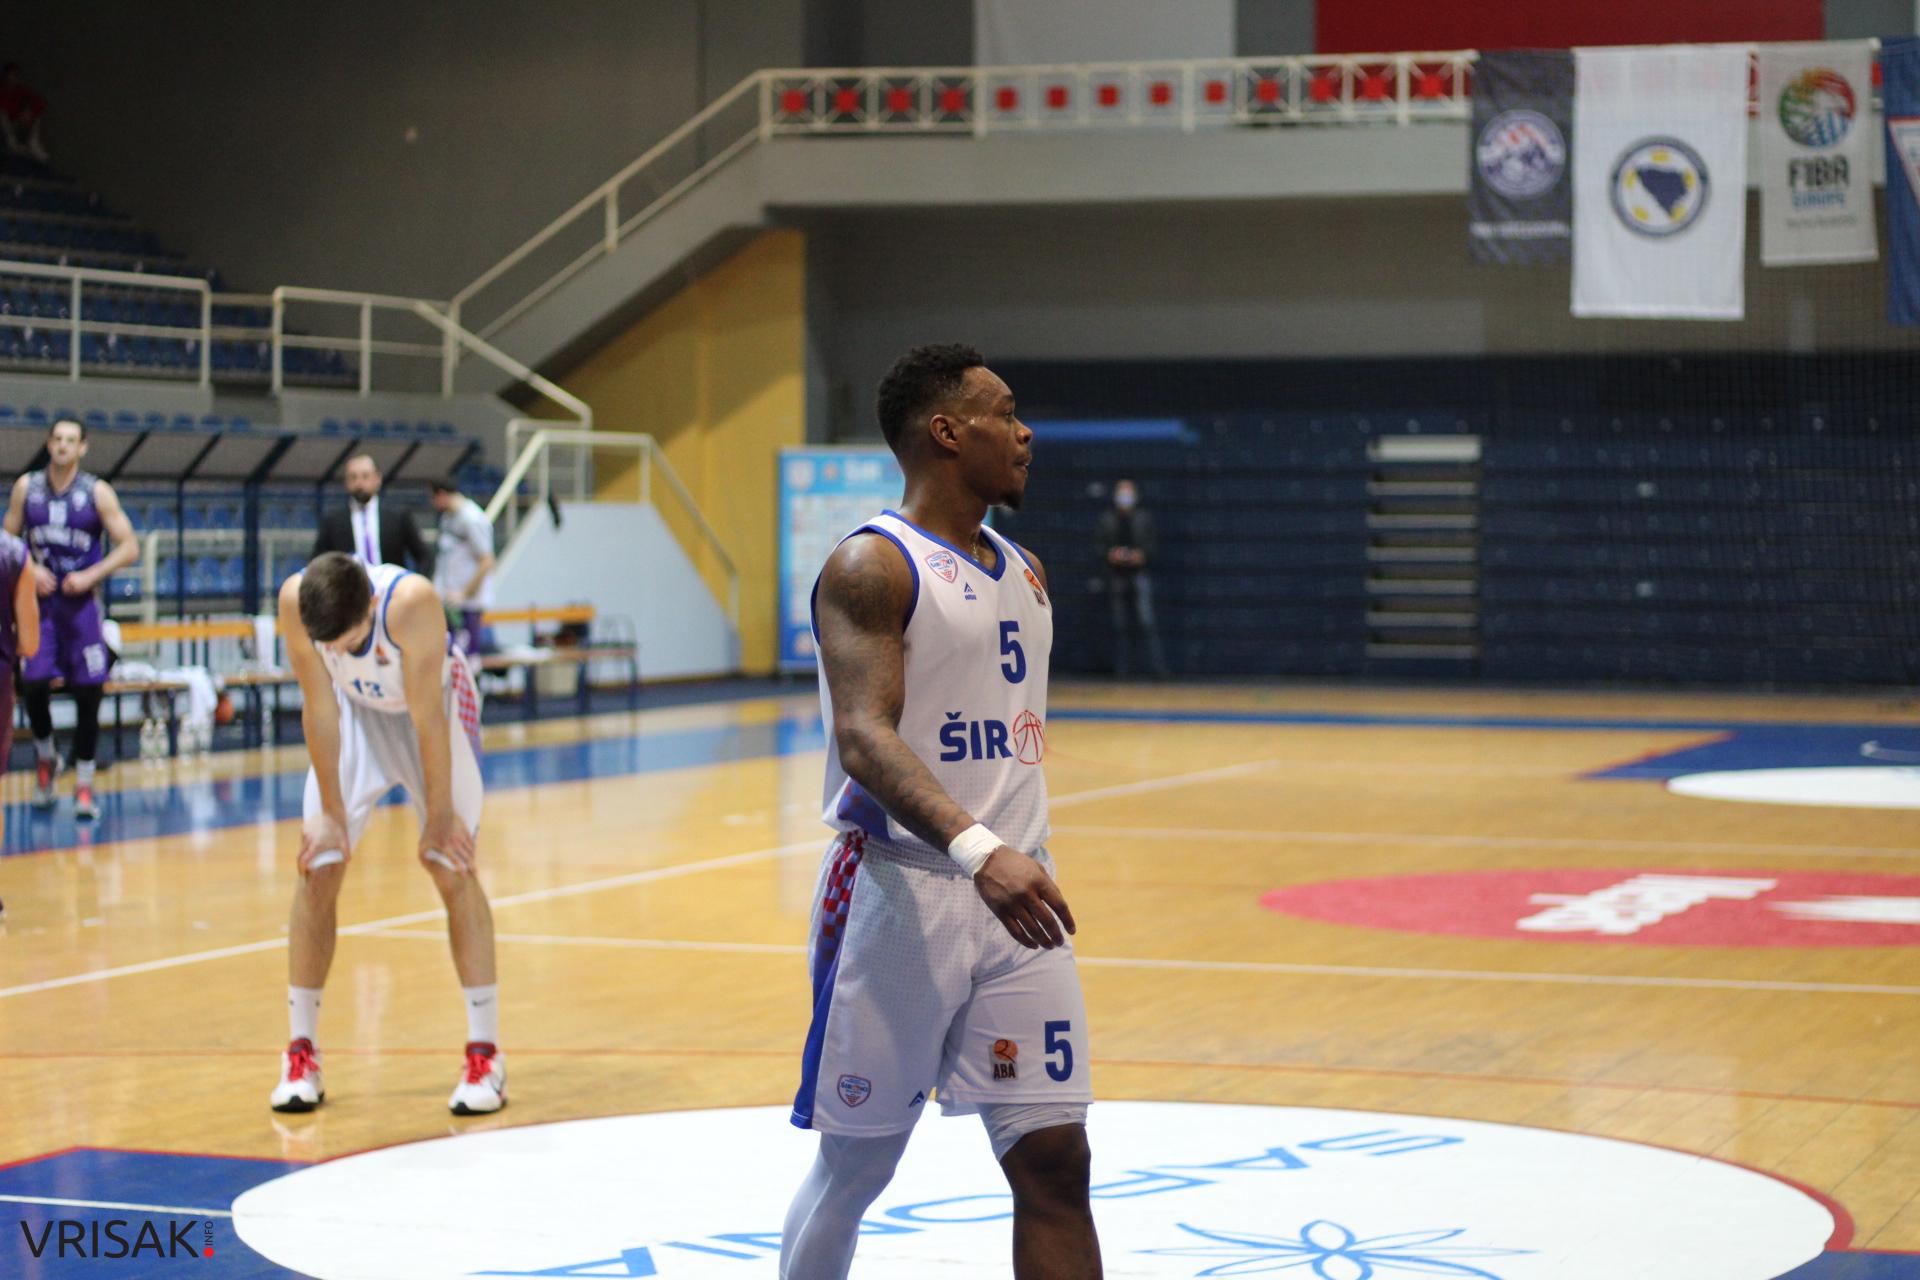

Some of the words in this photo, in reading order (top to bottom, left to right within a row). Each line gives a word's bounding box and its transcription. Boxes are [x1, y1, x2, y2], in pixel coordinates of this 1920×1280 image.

[1788, 155, 1850, 188] FIBA
[999, 620, 1027, 684] 5
[993, 1062, 1017, 1081] ABA
[1044, 1020, 1074, 1082] 5
